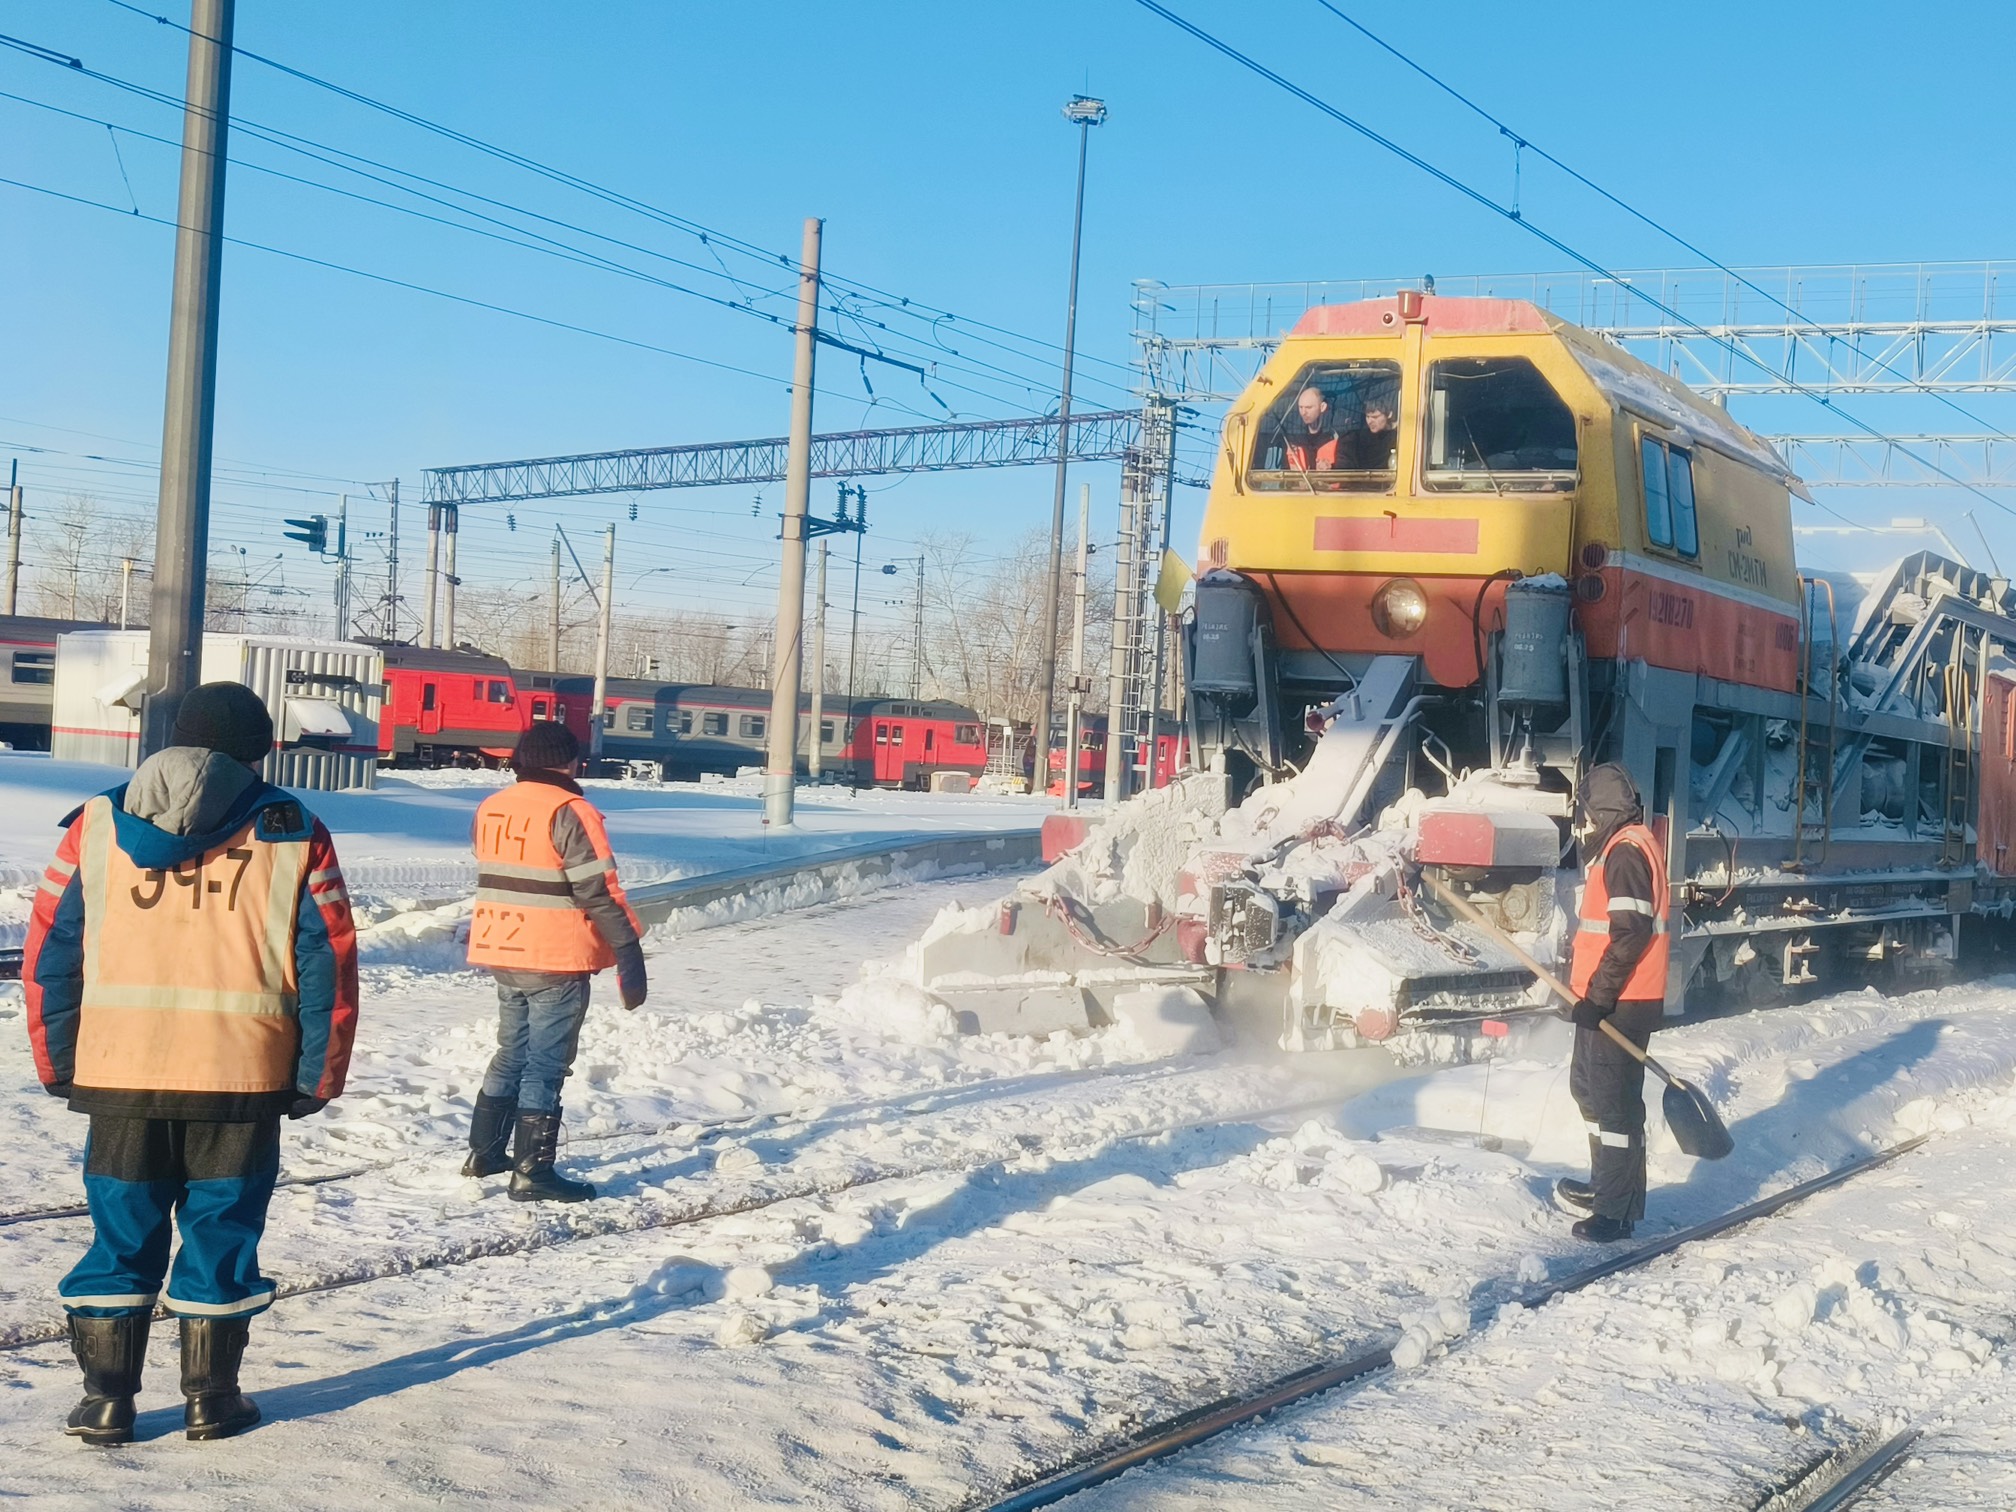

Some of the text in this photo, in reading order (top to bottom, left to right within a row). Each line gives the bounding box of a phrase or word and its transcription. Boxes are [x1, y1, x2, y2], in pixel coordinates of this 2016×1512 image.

[1158, 768, 1163, 776] 4
[482, 812, 531, 861] ПЧ
[476, 908, 526, 951] 22
